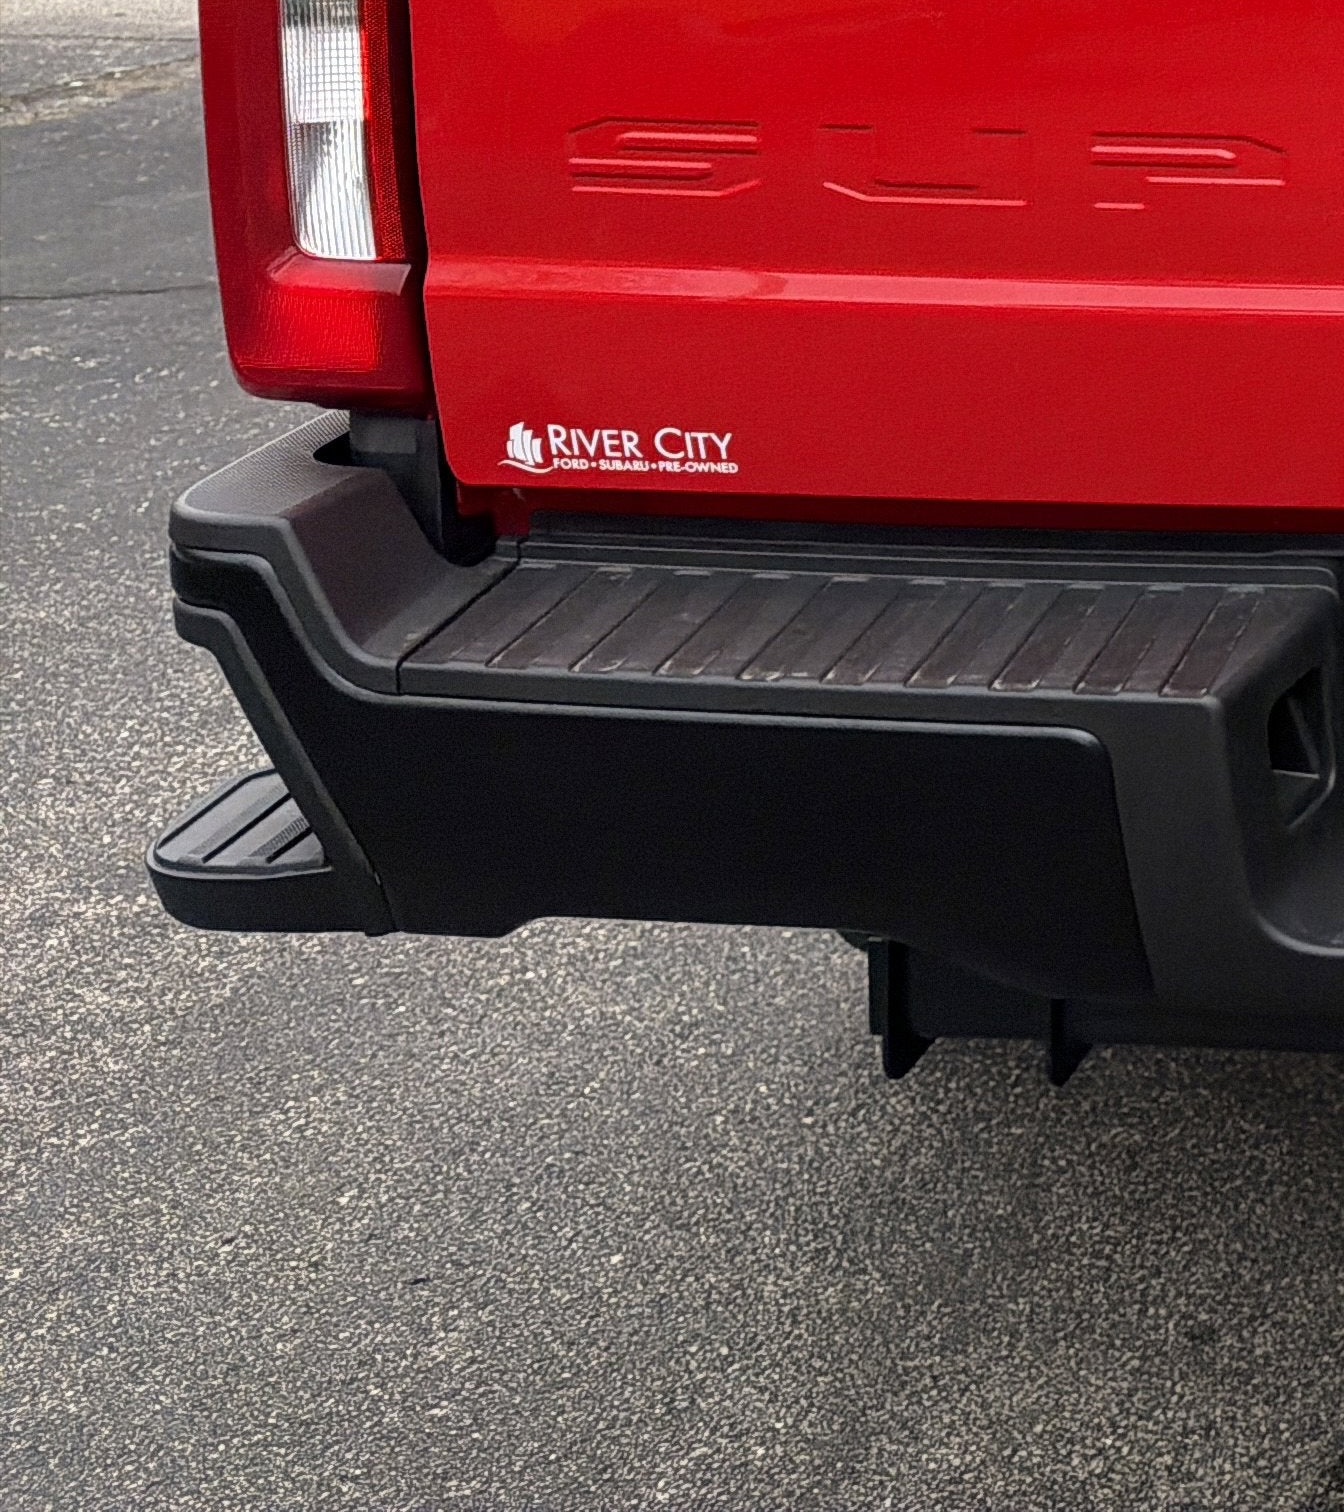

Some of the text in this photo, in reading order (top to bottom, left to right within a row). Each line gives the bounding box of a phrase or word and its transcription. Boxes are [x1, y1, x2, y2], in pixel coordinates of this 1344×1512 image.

[547, 423, 733, 460] RIVER CITY
[553, 458, 739, 474] FORD SUBARU PRE-OWNED
